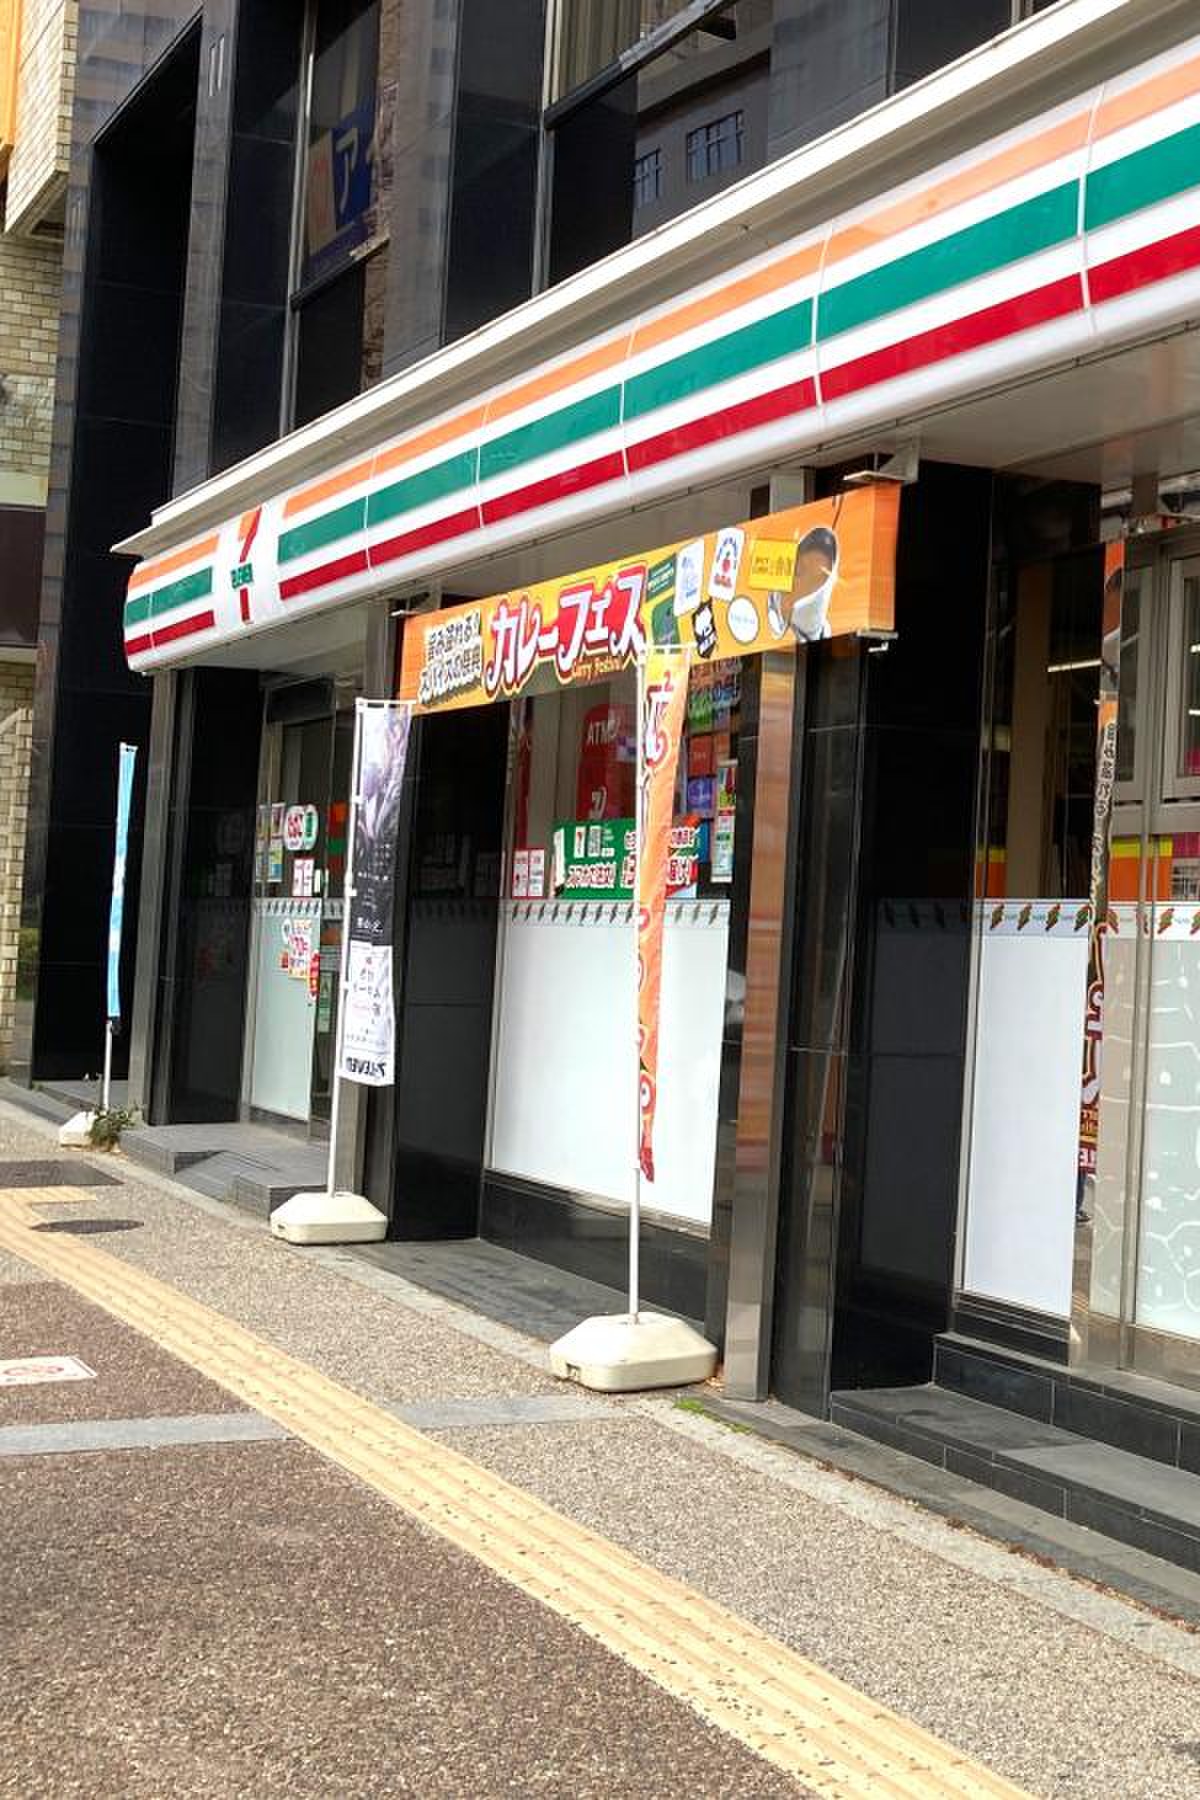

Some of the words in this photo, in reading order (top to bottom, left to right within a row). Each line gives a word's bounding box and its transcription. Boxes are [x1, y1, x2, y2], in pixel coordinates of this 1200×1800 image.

[485, 562, 647, 696] カレーフェス
